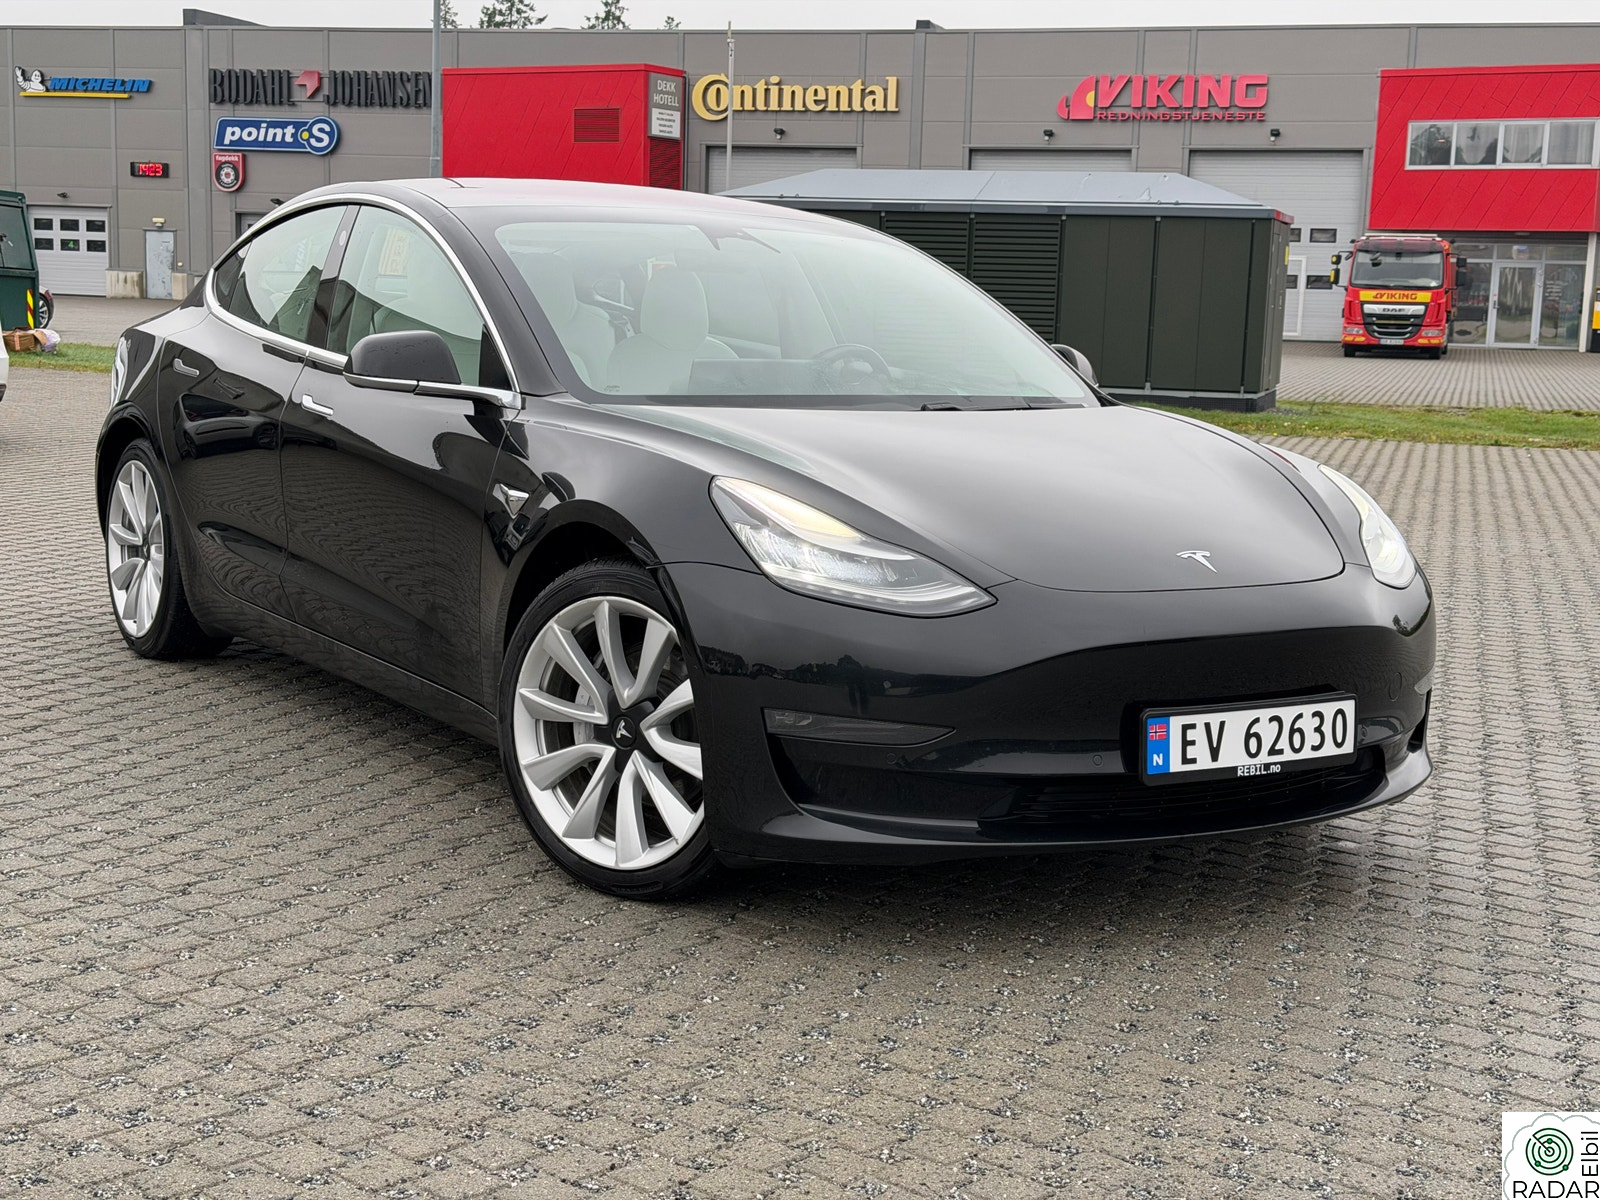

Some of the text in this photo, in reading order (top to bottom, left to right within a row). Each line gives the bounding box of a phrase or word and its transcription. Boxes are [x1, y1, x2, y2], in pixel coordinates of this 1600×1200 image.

[48, 76, 152, 93] MICHELIN
[209, 68, 432, 108] BODAHL JOHANSEN
[657, 79, 676, 92] DEKK
[1098, 74, 1269, 108] VIKING
[653, 93, 679, 107] HOTELL
[692, 73, 899, 121] Continental
[1096, 111, 1266, 121] REDNINGSTJENESTE
[223, 122, 331, 148] point S
[67, 240, 75, 248] 4
[1380, 292, 1418, 300] VIKING
[1180, 707, 1348, 766] EV 62630
[1152, 753, 1164, 766] N
[1237, 764, 1282, 777] REBIL.no
